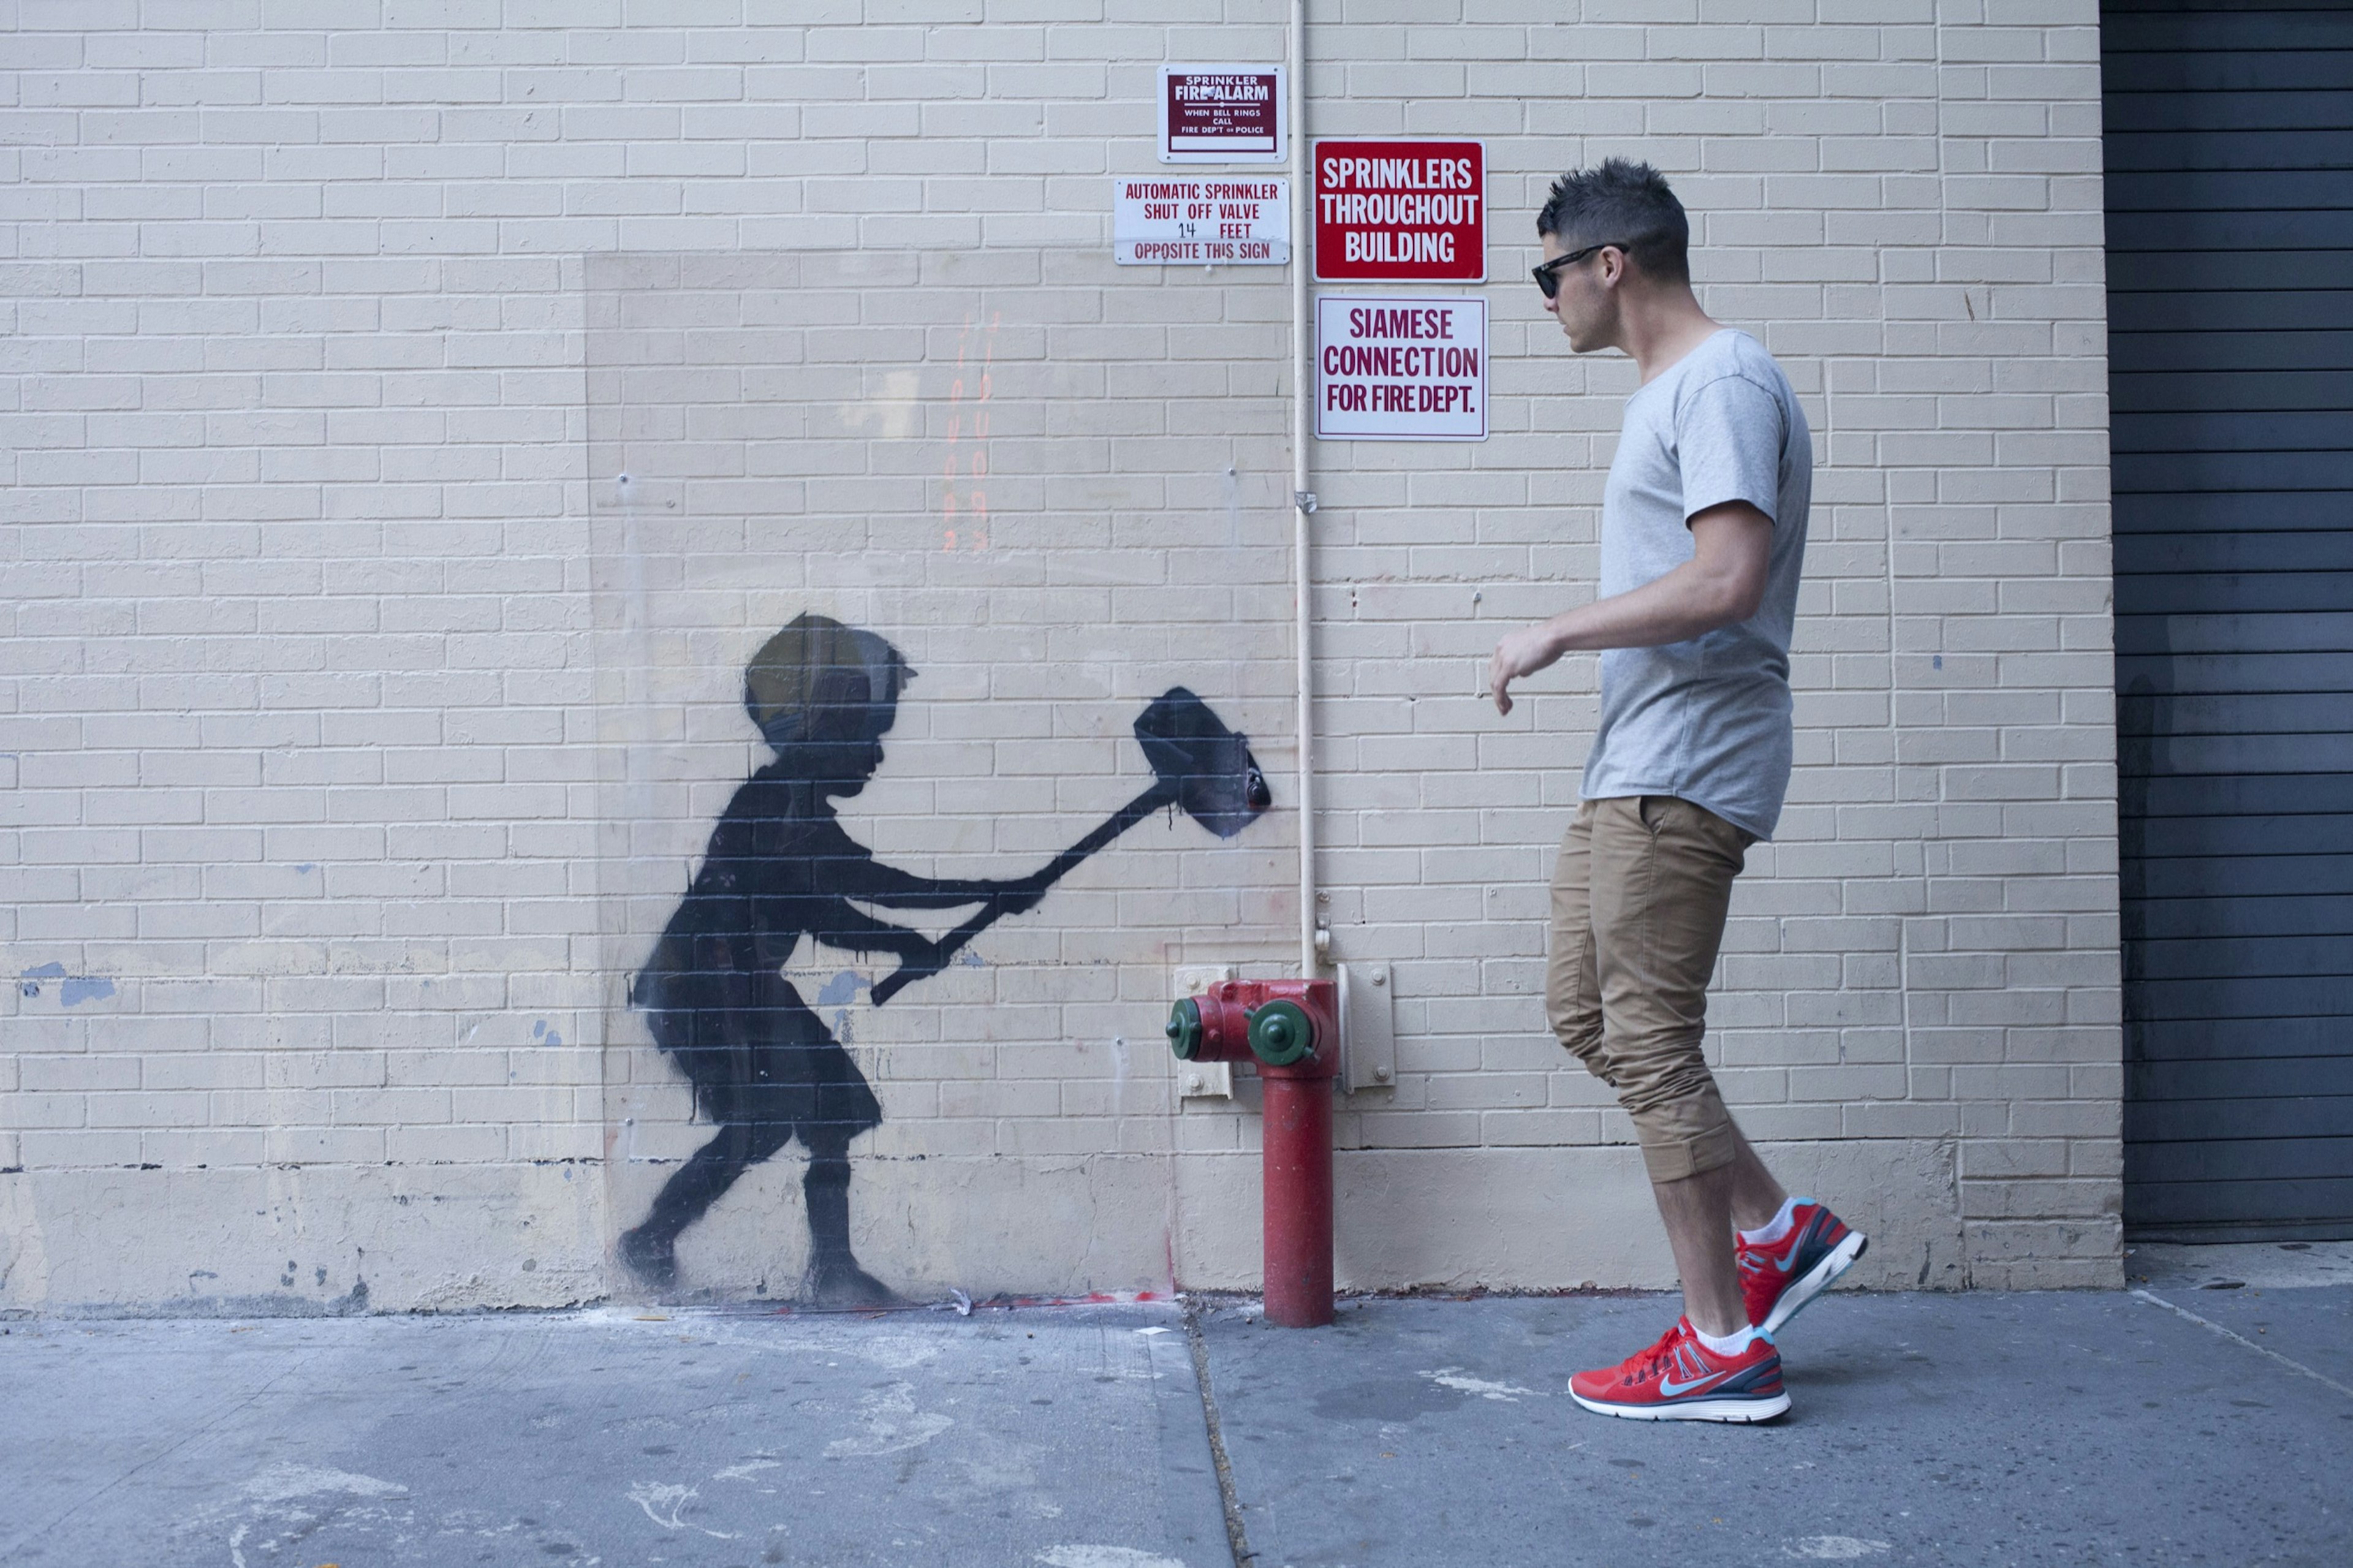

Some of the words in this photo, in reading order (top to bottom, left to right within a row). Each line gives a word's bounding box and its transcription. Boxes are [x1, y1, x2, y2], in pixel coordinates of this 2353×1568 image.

[1186, 76, 1257, 85] SPRINKLER
[1175, 86, 1208, 100] FIRE
[1214, 86, 1268, 100] ALARM
[1323, 157, 1472, 189] SPRINKLERS
[1126, 184, 1200, 199] AUTOMATIC
[1205, 184, 1278, 199] SPRINKLER
[1144, 204, 1179, 219] SHUT
[1188, 204, 1213, 219] OFF
[1219, 204, 1259, 219] VALVE
[1320, 194, 1479, 225] THROUGHOUT
[1178, 222, 1196, 238] 14
[1220, 224, 1251, 238] FEET
[1135, 243, 1199, 259] OPPOSITE
[1205, 243, 1233, 259] THIS
[1240, 243, 1270, 259] SIGN
[1345, 232, 1455, 262] BUILDING
[1350, 308, 1453, 339] SIAMESE
[1324, 346, 1478, 377] CONNECTION
[1328, 384, 1366, 411] FOR
[1372, 385, 1415, 412] FIRE
[1419, 385, 1475, 412] DEPT.
